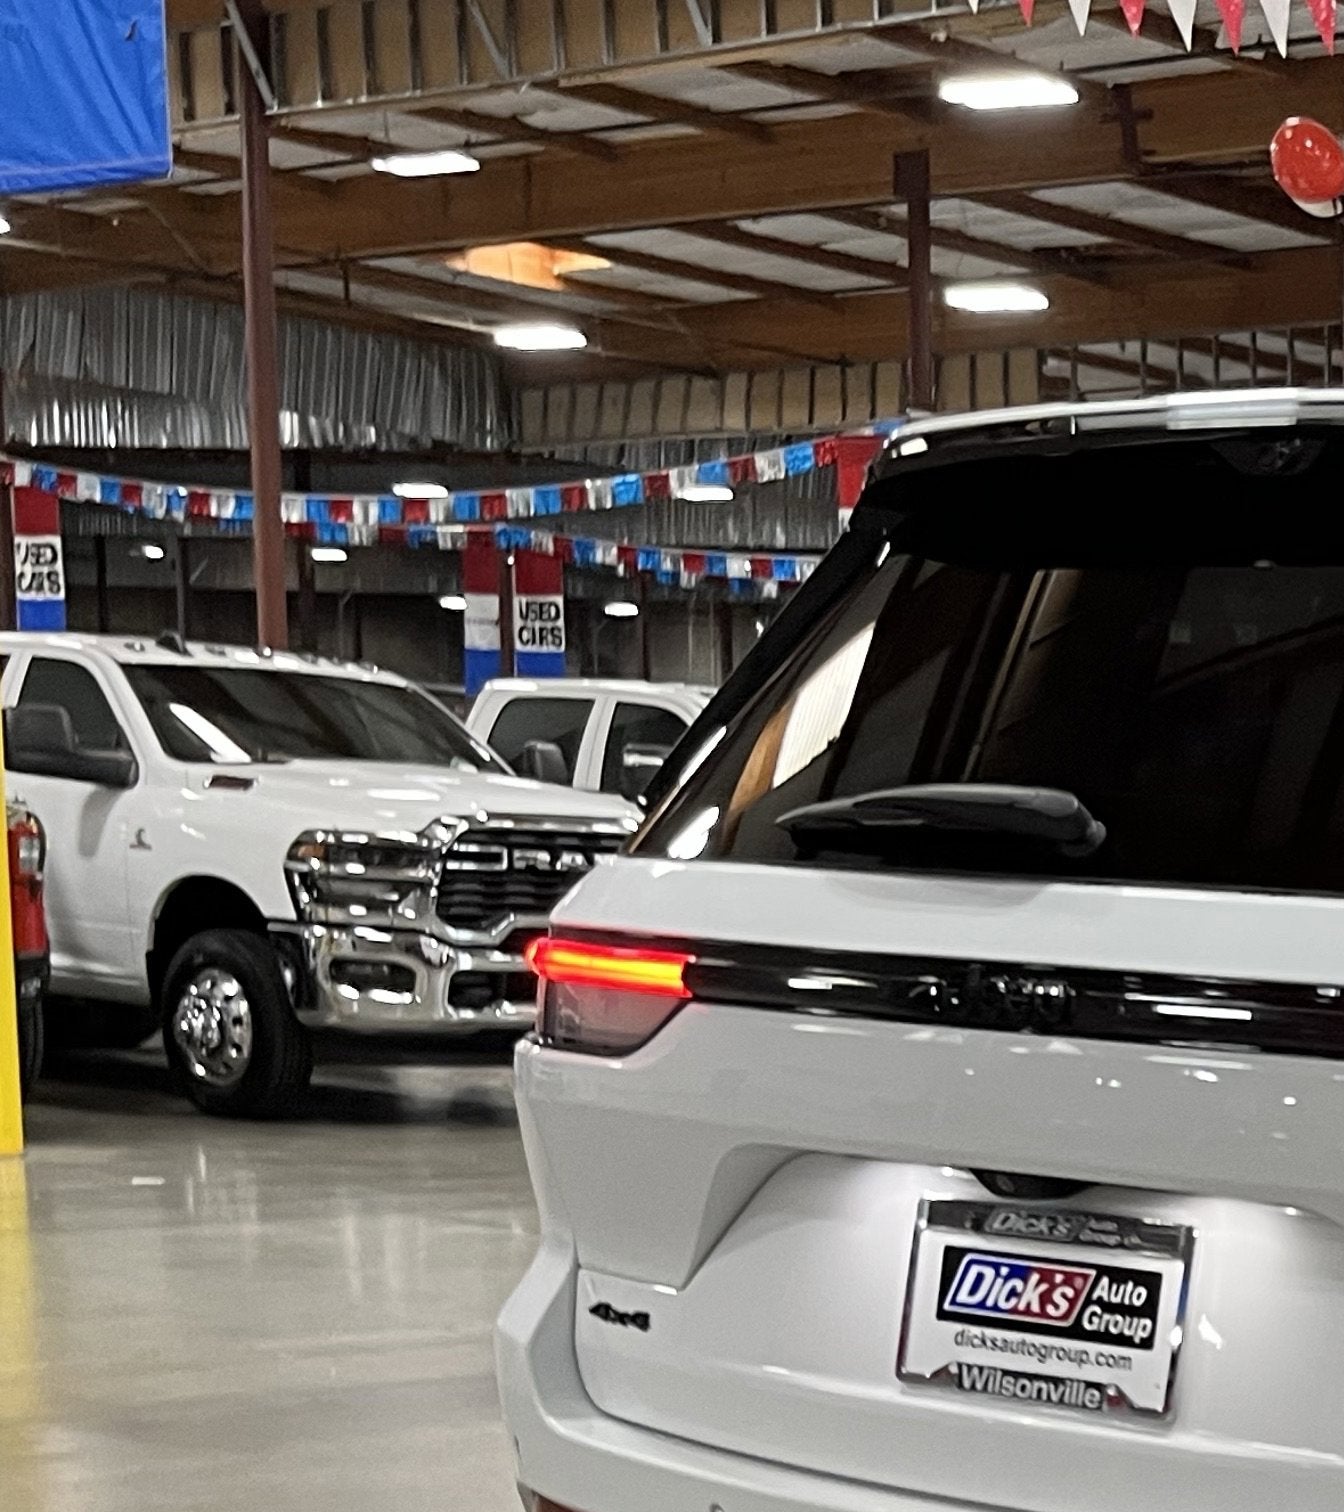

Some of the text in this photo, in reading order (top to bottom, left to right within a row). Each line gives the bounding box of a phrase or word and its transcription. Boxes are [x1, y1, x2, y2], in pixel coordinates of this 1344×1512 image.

[519, 601, 560, 622] USED
[955, 1263, 1076, 1318] Dick's
[1092, 1278, 1148, 1307] Auto
[1081, 1305, 1153, 1342] Group
[953, 1329, 1133, 1371] dicksautogroup.com
[959, 1362, 1102, 1409] Wilsonville
